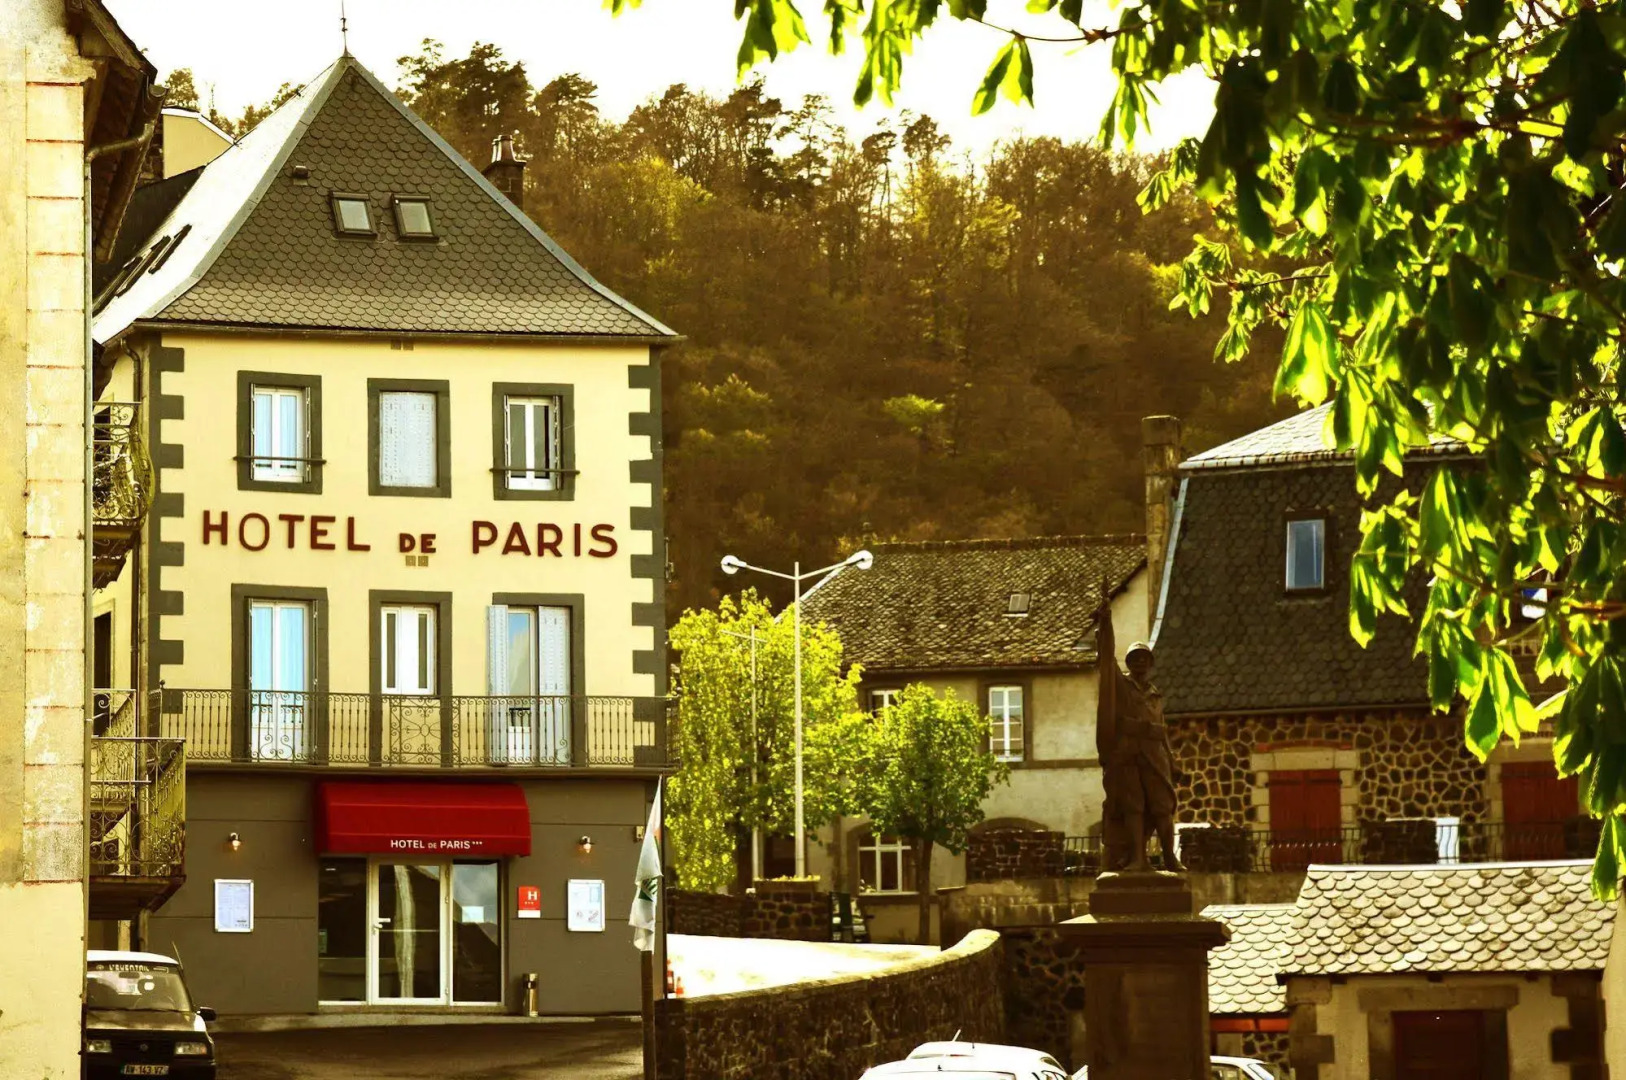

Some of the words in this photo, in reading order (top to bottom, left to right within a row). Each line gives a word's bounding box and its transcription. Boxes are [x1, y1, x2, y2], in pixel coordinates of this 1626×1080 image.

[202, 509, 371, 553] HOTEL
[398, 533, 437, 554] DE
[471, 520, 619, 559] PARIS
[390, 839, 425, 849] HOTEL
[527, 890, 538, 900] H
